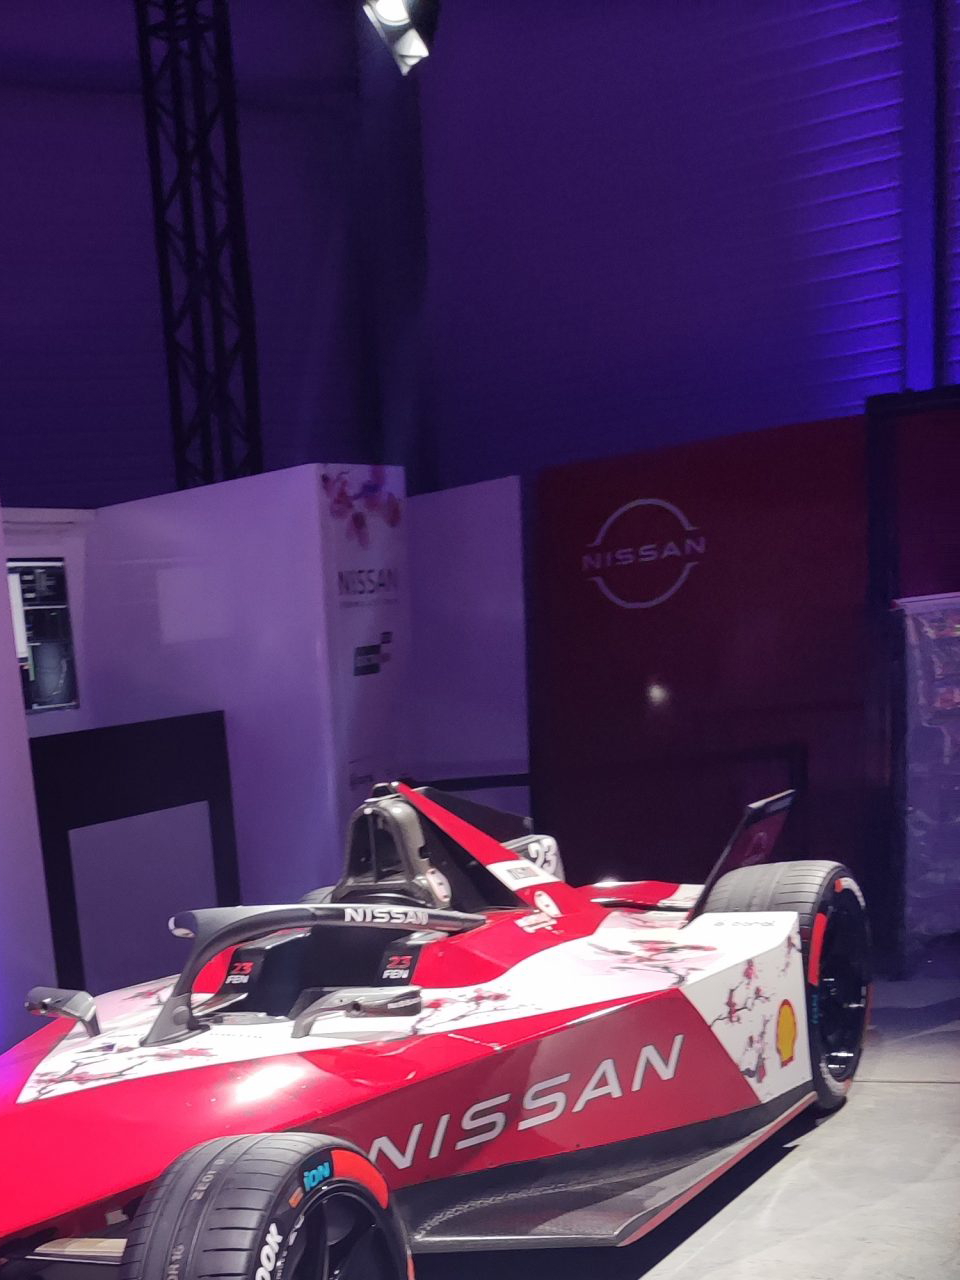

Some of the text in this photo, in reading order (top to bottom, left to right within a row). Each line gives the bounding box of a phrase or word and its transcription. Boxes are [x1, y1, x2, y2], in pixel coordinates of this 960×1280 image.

[582, 536, 705, 571] NISSAN
[344, 908, 429, 925] NISSAN
[229, 962, 254, 974] 23
[386, 955, 413, 969] 23
[382, 969, 410, 979] FEN
[369, 1035, 684, 1171] NISSAN
